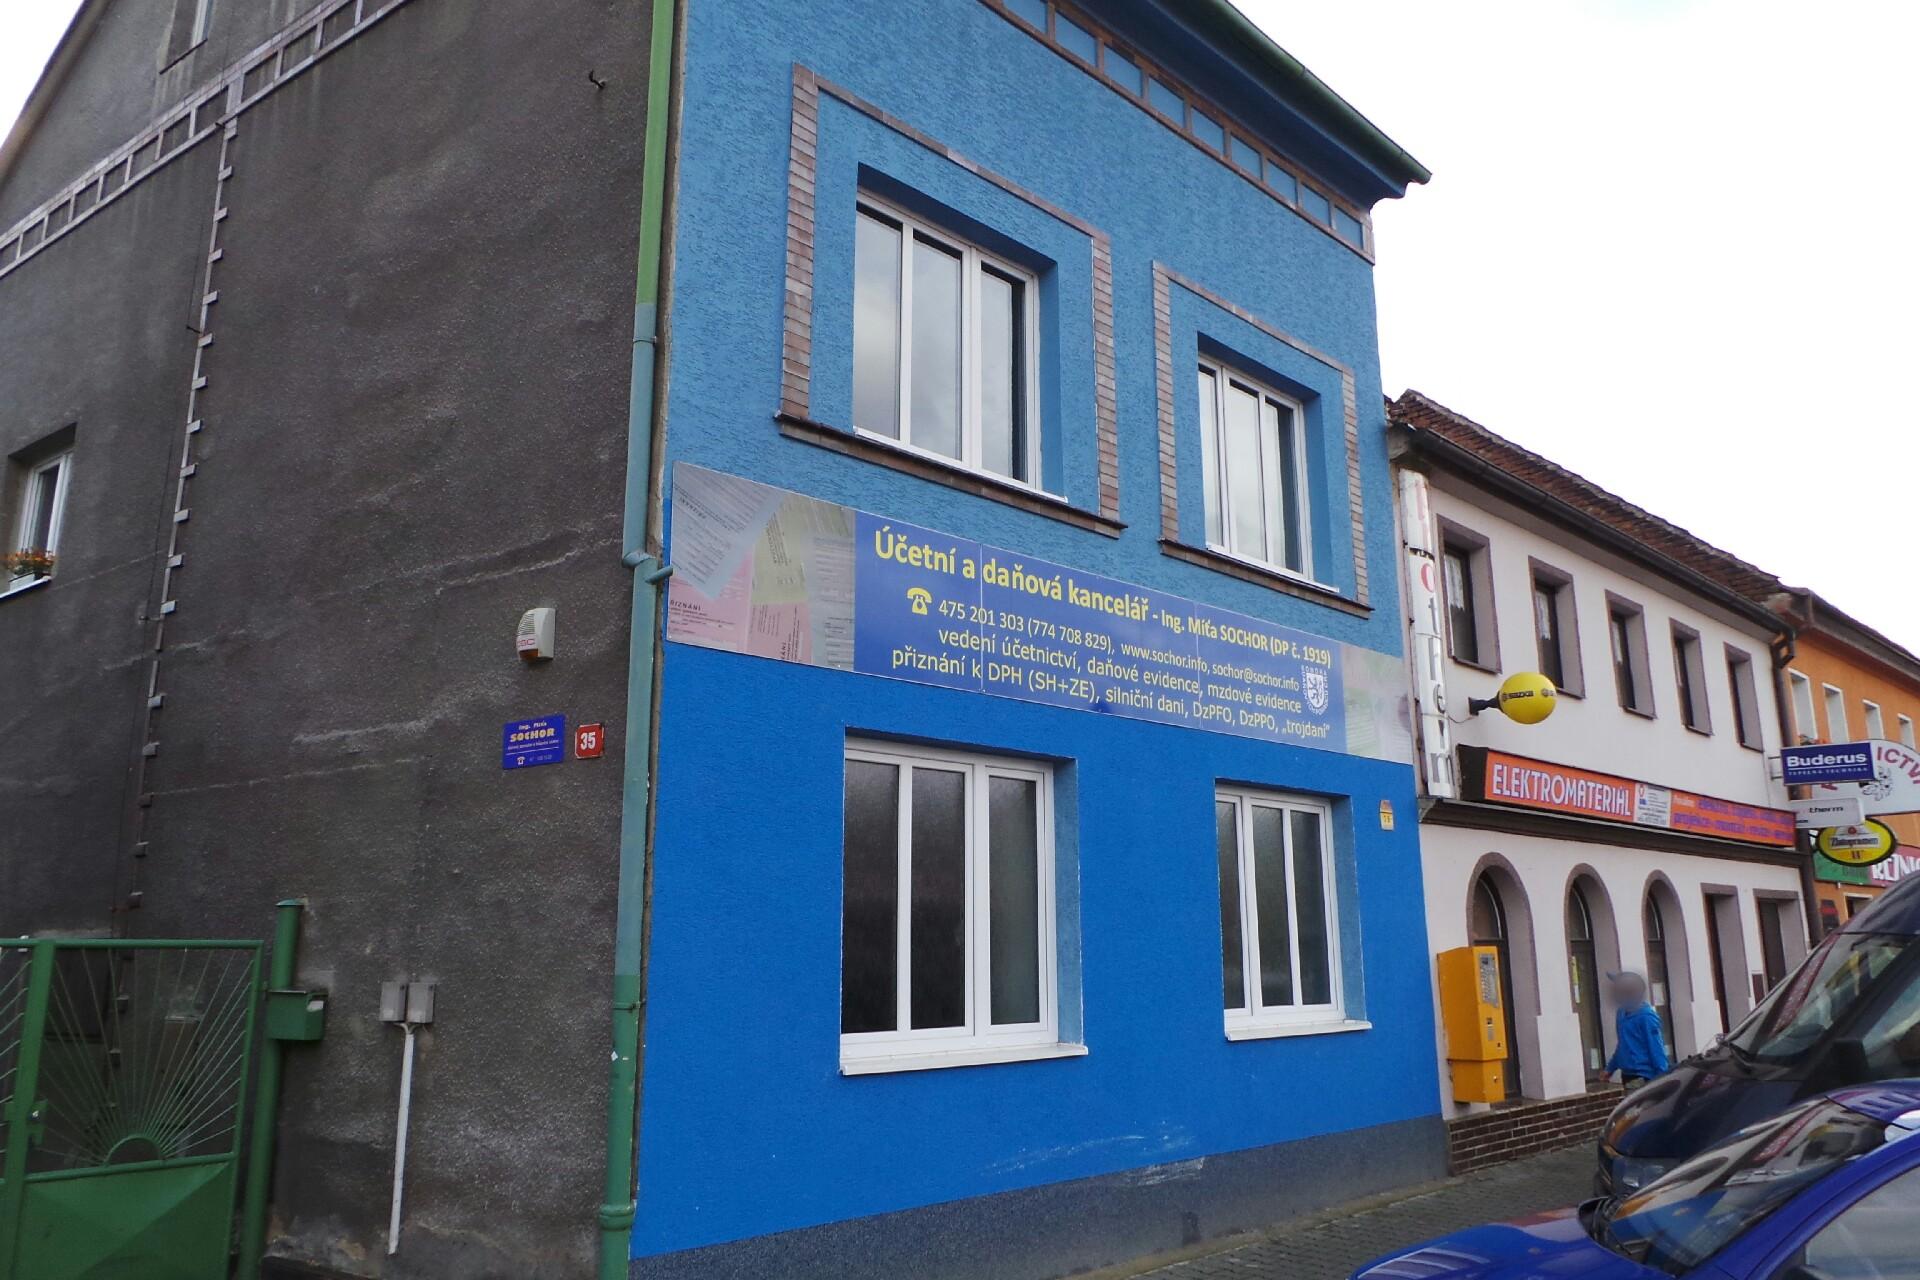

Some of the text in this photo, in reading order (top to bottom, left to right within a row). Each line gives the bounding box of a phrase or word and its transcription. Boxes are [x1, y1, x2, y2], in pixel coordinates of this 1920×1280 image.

[875, 525, 956, 574] Účetní
[962, 559, 975, 579] a
[983, 558, 1062, 600] daňová
[1068, 577, 1149, 621] kancelář
[1161, 610, 1185, 633] Ing.
[1220, 625, 1268, 651] SOCHOR
[1270, 635, 1289, 656] (DP
[1292, 643, 1300, 659] č.
[1303, 647, 1331, 669] 1919)
[938, 600, 1300, 692] 475 201 303 (774 708 829), www.sochor.info, sochor@sochor.info
[938, 629, 996, 654] vedení
[1002, 637, 1081, 674] účetnictví,
[1088, 657, 1138, 681] daňové
[1143, 670, 1203, 698] evidence,
[1208, 684, 1252, 704] mzdové
[1255, 693, 1302, 713] evidence
[892, 645, 966, 674] přiznání
[972, 659, 982, 678] k
[988, 663, 1022, 685] DPH
[1028, 670, 1100, 703] (SH+ZE),
[1106, 687, 1153, 709] silniční
[1157, 695, 1188, 719] dani,
[1193, 702, 1235, 726] DzPFO,
[1240, 710, 1278, 734] DzPPO,
[510, 728, 555, 743] SOCHOR
[580, 732, 596, 750] 35
[1786, 753, 1867, 767] Buderus
[1492, 763, 1631, 816] ELEKTROMATERIÁL
